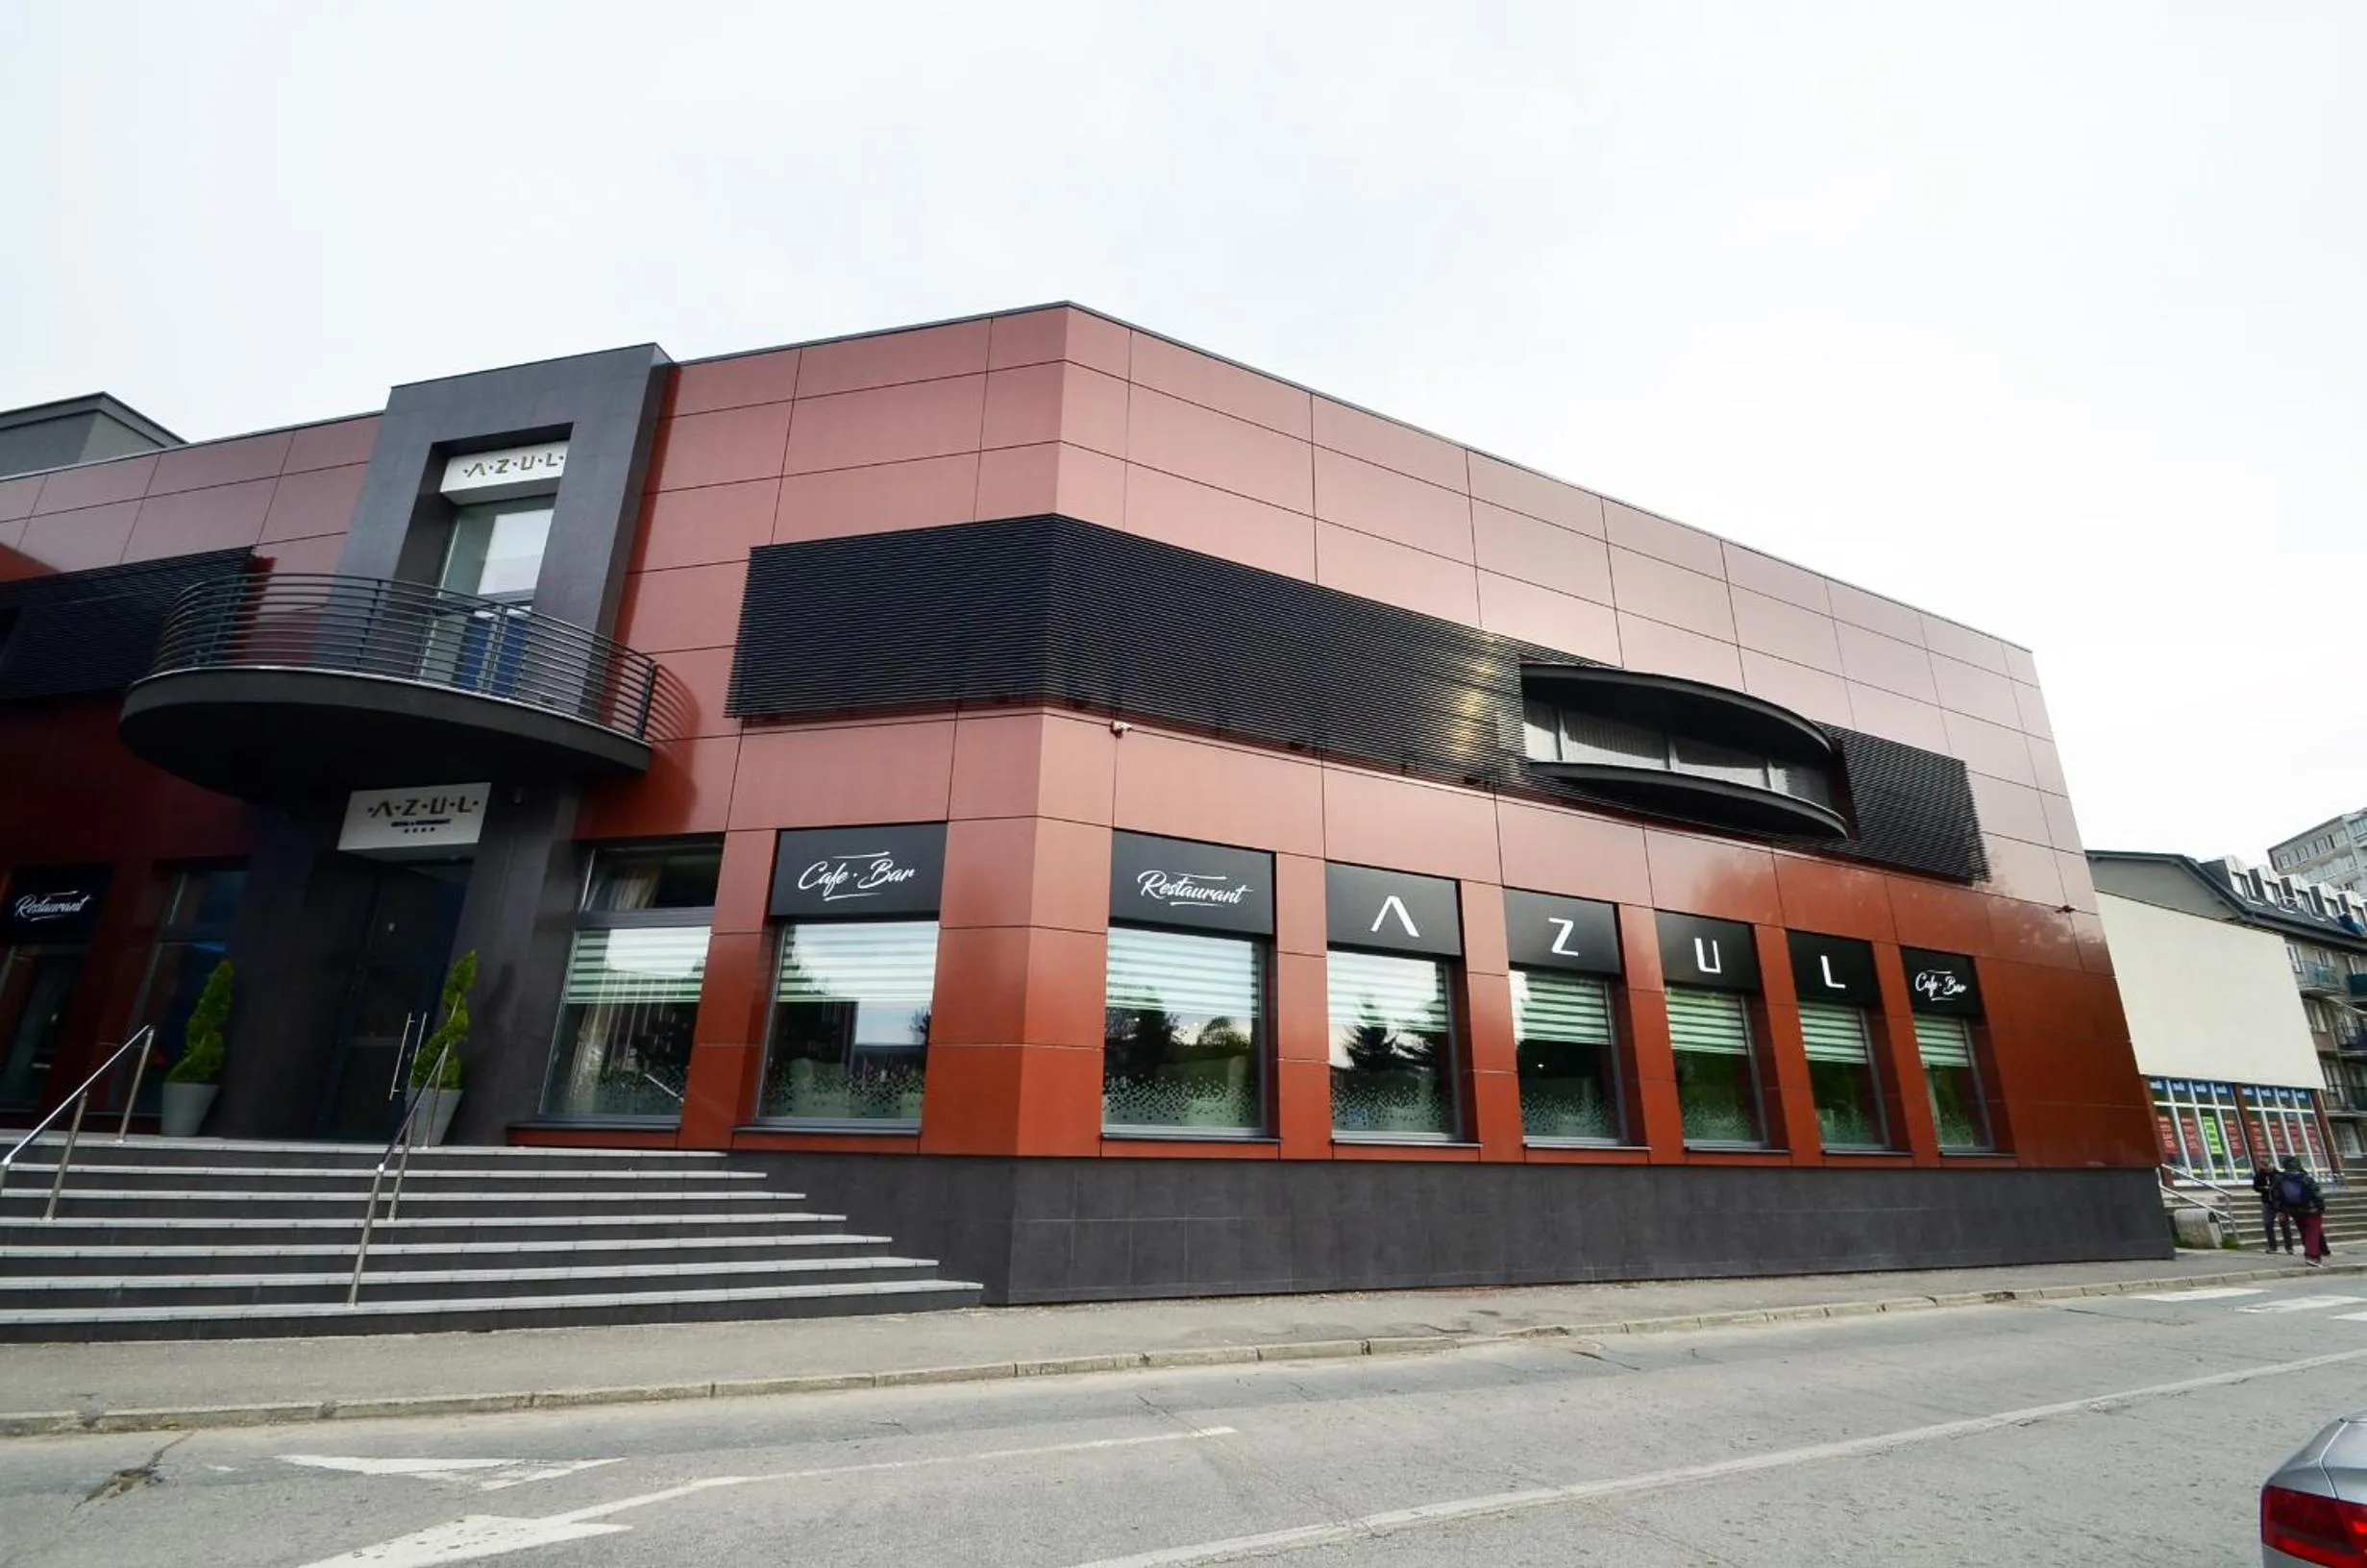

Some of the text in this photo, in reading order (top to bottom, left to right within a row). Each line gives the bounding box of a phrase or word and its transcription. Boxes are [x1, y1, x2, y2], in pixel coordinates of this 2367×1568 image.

[798, 858, 916, 897] Cafe Bar
[1137, 870, 1254, 904] Restaurant
[14, 894, 92, 919] Restaurant
[1548, 917, 1579, 957] Z
[1693, 937, 1721, 974] U
[1820, 955, 1846, 989] L
[1914, 971, 1967, 998] Cafe Bar
